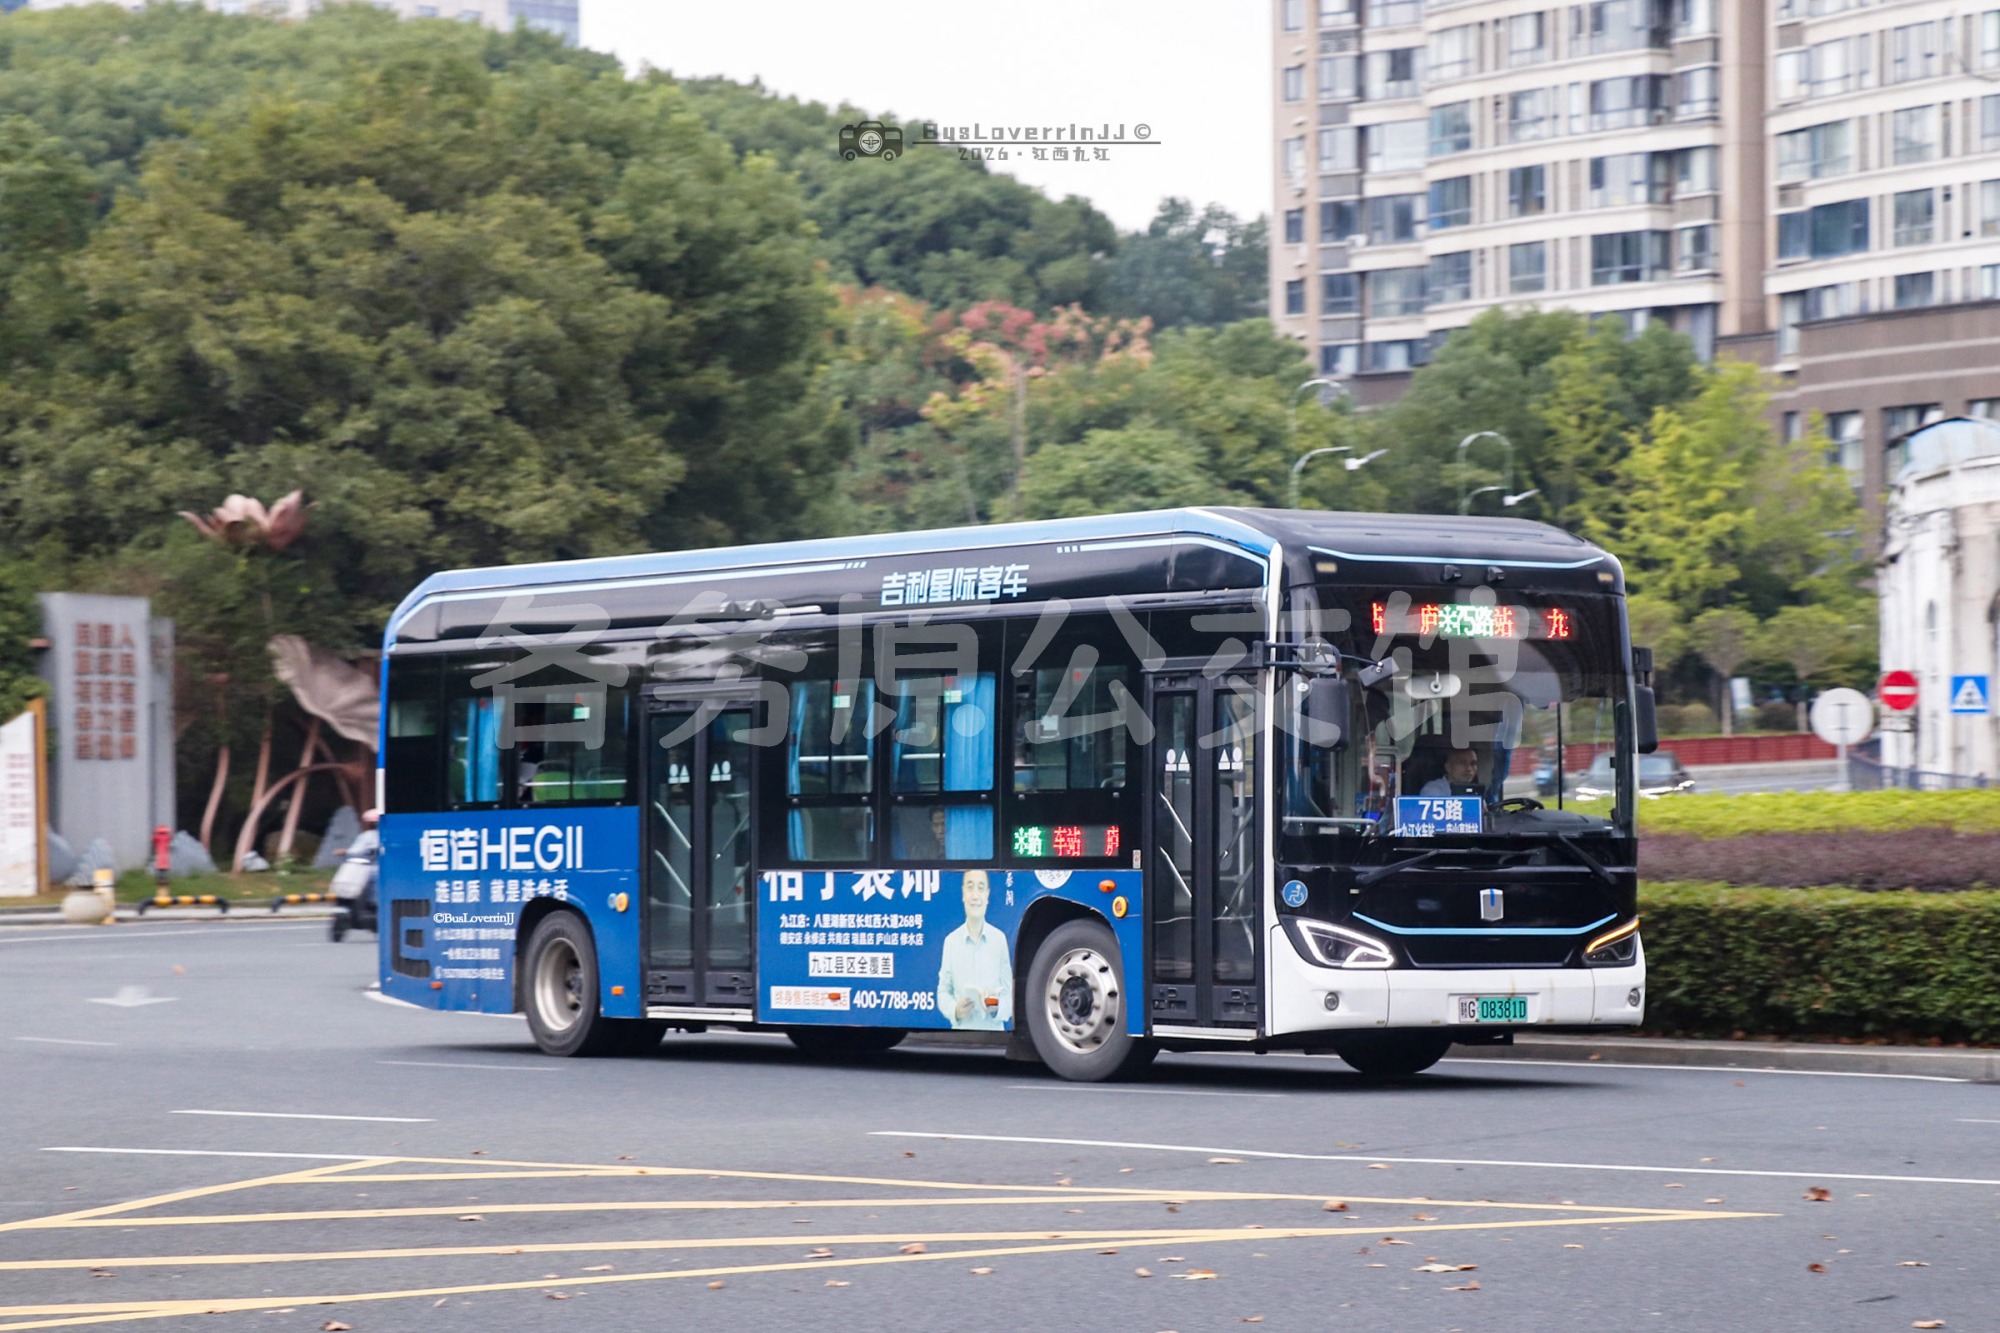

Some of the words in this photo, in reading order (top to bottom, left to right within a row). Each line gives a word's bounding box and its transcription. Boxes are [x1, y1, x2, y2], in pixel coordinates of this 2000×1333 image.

[881, 563, 1030, 606] 吉利星际客车
[1418, 800, 1463, 821] 75路
[435, 880, 481, 903] 选品质
[876, 932, 899, 946] 庐山店
[811, 955, 891, 976] 九江县区全覆盖
[853, 990, 935, 1010] 400-7788-985
